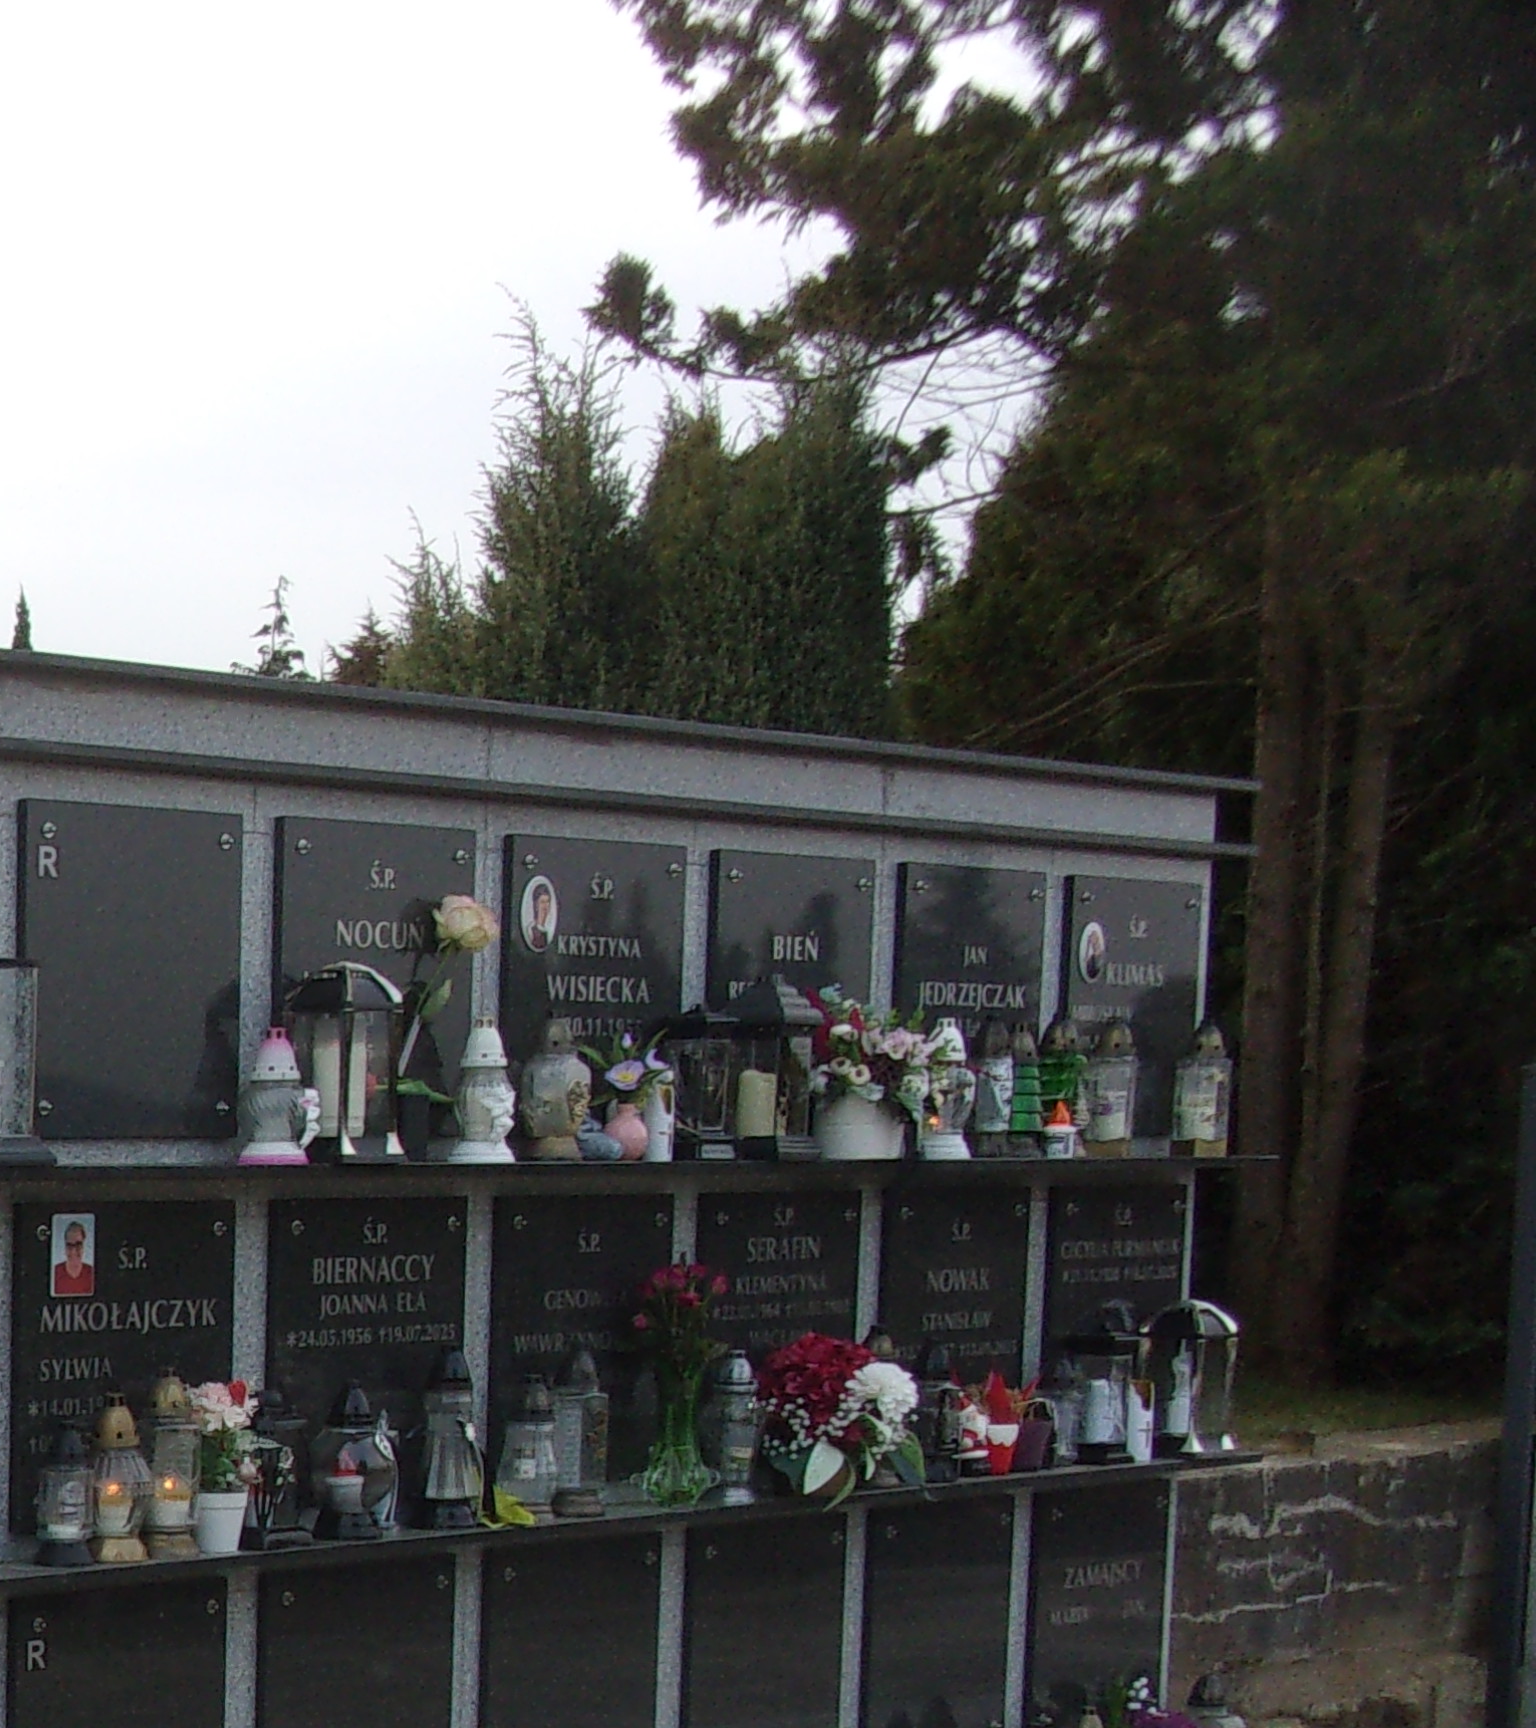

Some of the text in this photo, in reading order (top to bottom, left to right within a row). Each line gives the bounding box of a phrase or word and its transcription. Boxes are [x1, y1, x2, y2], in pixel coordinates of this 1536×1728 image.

[38, 845, 59, 878] R
[558, 935, 642, 958] KRYSTYNA
[773, 930, 819, 961] BIEŃ
[963, 945, 988, 967] JAN
[548, 974, 650, 1004] WISIECKA
[312, 1254, 436, 1284] BIERNACCY
[39, 1299, 217, 1335] MIKOŁAJCZYK
[319, 1294, 389, 1320] JOANNA
[39, 1356, 114, 1382] SYLWIA
[26, 1640, 47, 1671] R
